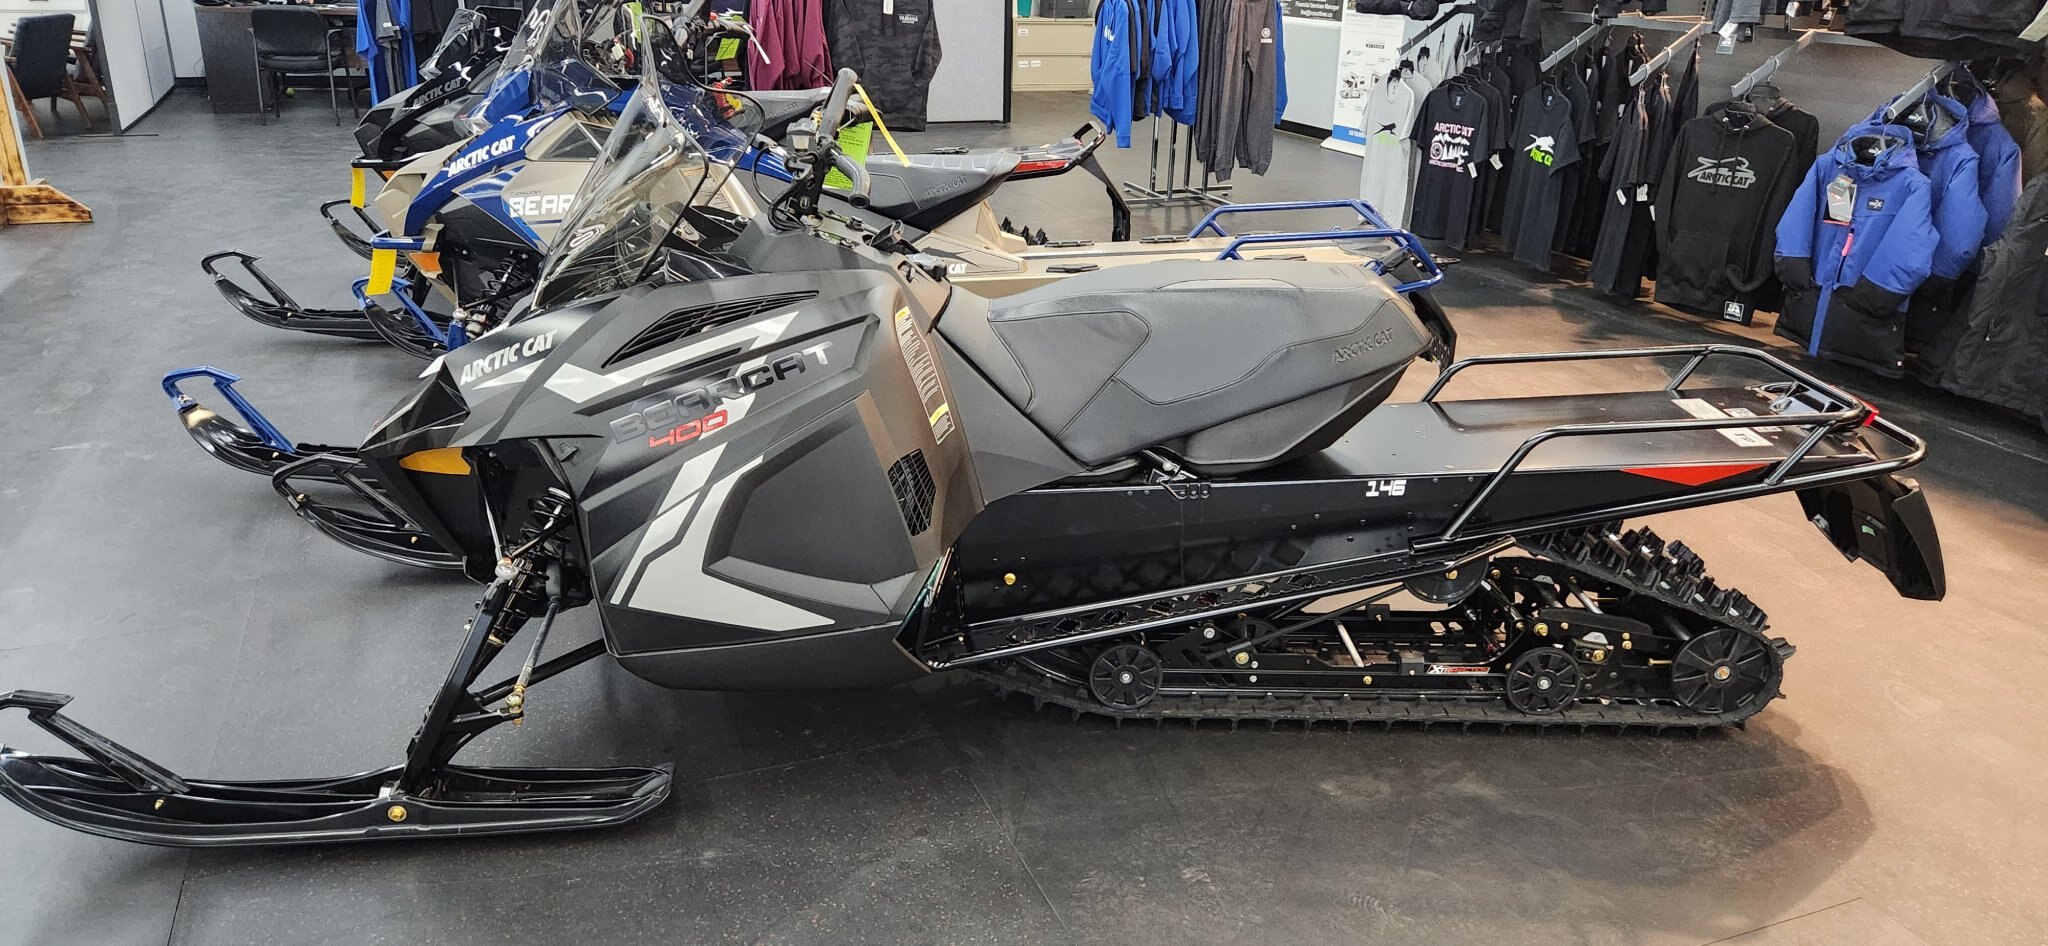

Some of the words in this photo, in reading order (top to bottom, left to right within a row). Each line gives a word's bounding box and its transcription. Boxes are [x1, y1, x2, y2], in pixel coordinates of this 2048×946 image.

[444, 77, 461, 92] CAT
[1434, 122, 1461, 134] ARCTIC
[448, 145, 490, 177] ARCTIC
[491, 135, 515, 156] CAT
[948, 263, 967, 274] CAT
[460, 343, 520, 386] ARCTIC
[522, 329, 558, 357] CAT
[1334, 336, 1373, 363] ARCTIC
[1374, 327, 1393, 347] CAT
[609, 341, 833, 444] BEARCAT
[649, 409, 728, 448] 400
[1365, 479, 1407, 497] 146
